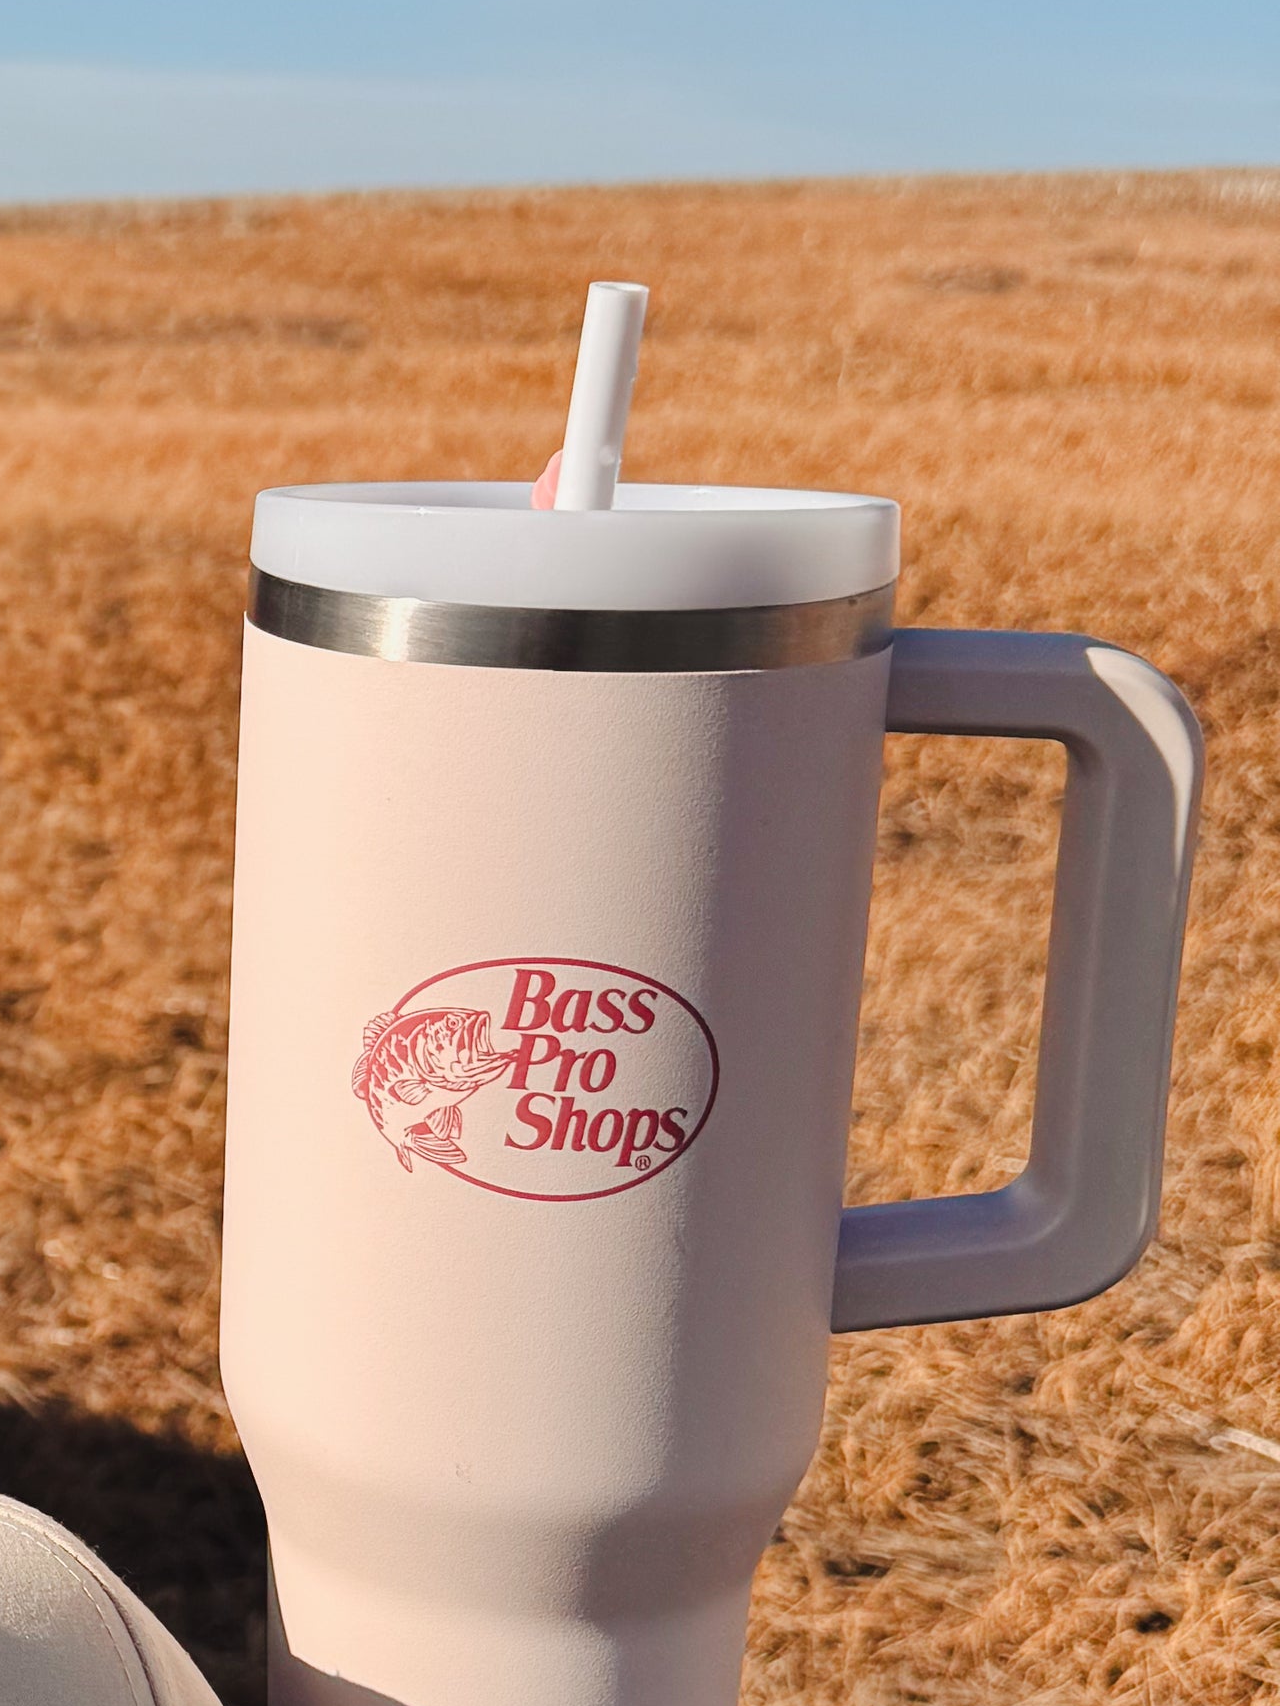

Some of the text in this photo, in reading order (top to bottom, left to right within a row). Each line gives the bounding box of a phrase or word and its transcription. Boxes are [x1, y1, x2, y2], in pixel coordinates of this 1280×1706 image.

[500, 968, 658, 1035] Bass
[506, 1033, 617, 1094] Pro
[503, 1093, 689, 1168] Shops
